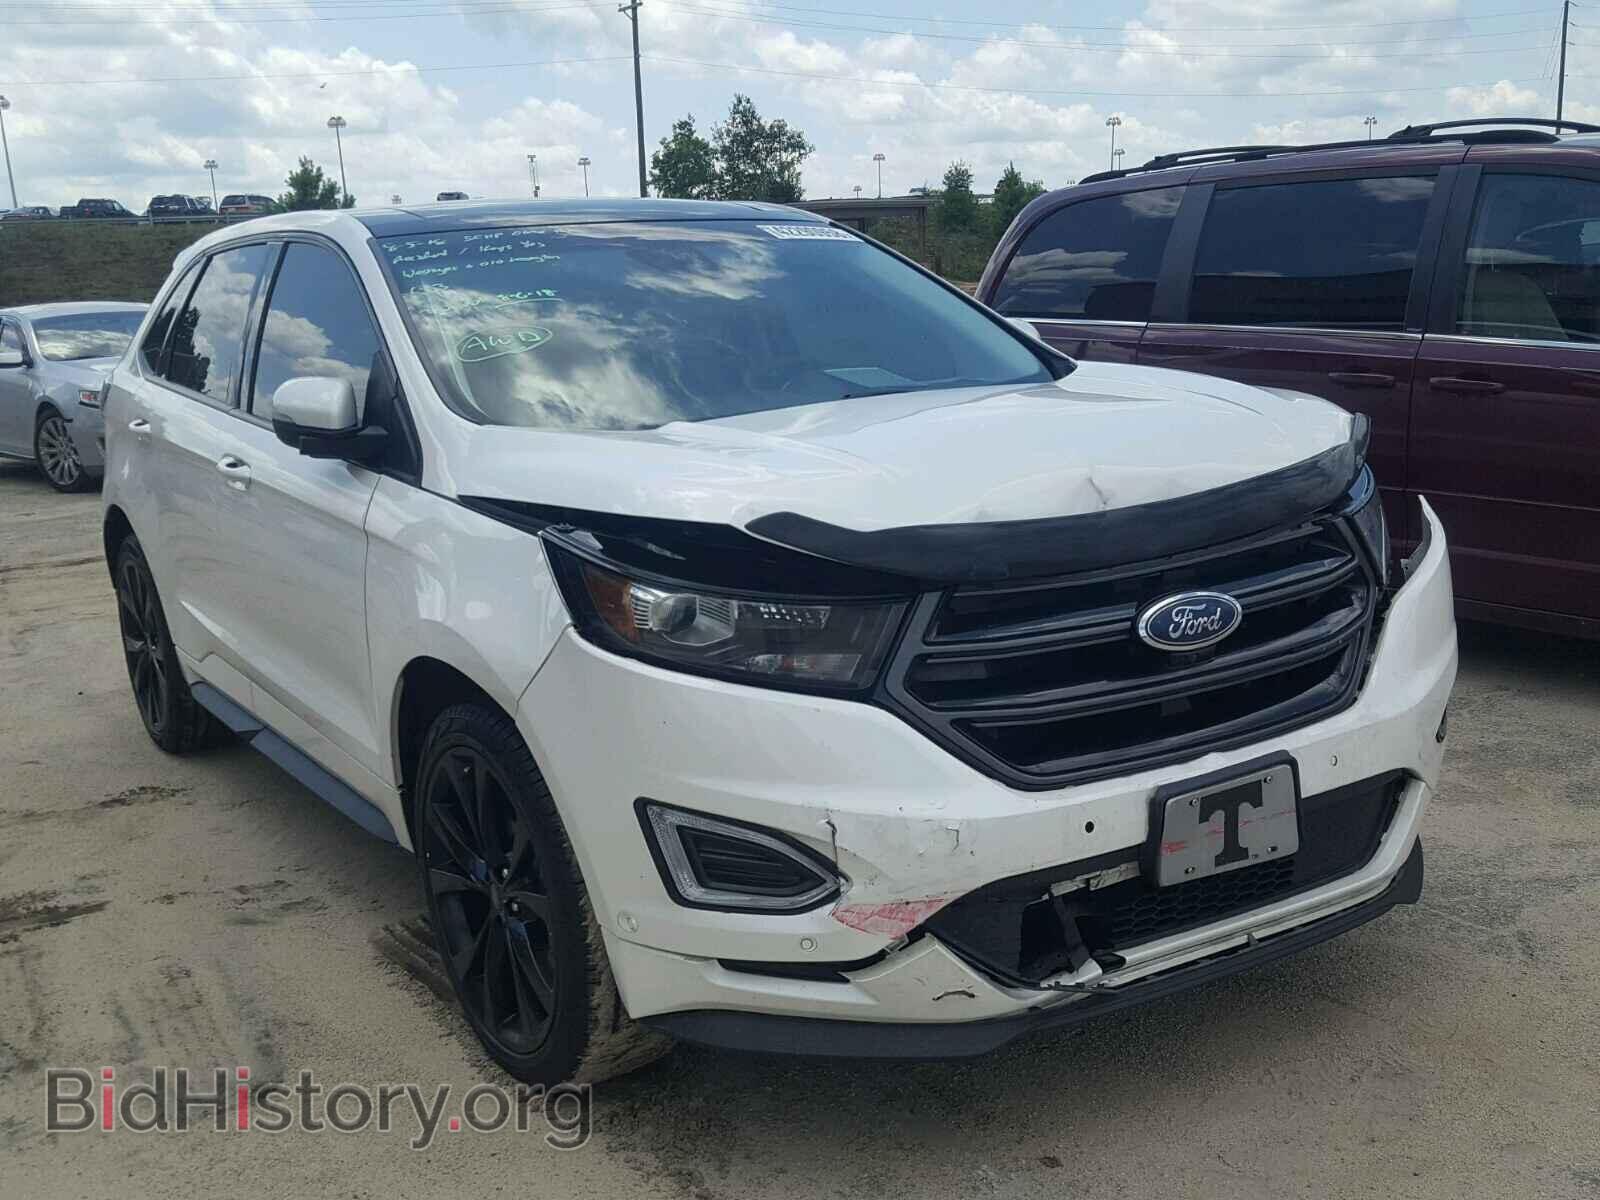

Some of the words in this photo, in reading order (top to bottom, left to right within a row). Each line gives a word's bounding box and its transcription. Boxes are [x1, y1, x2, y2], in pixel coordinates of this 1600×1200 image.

[460, 331, 542, 355] AWD
[1168, 603, 1223, 639] Ford
[1198, 780, 1263, 867] T
